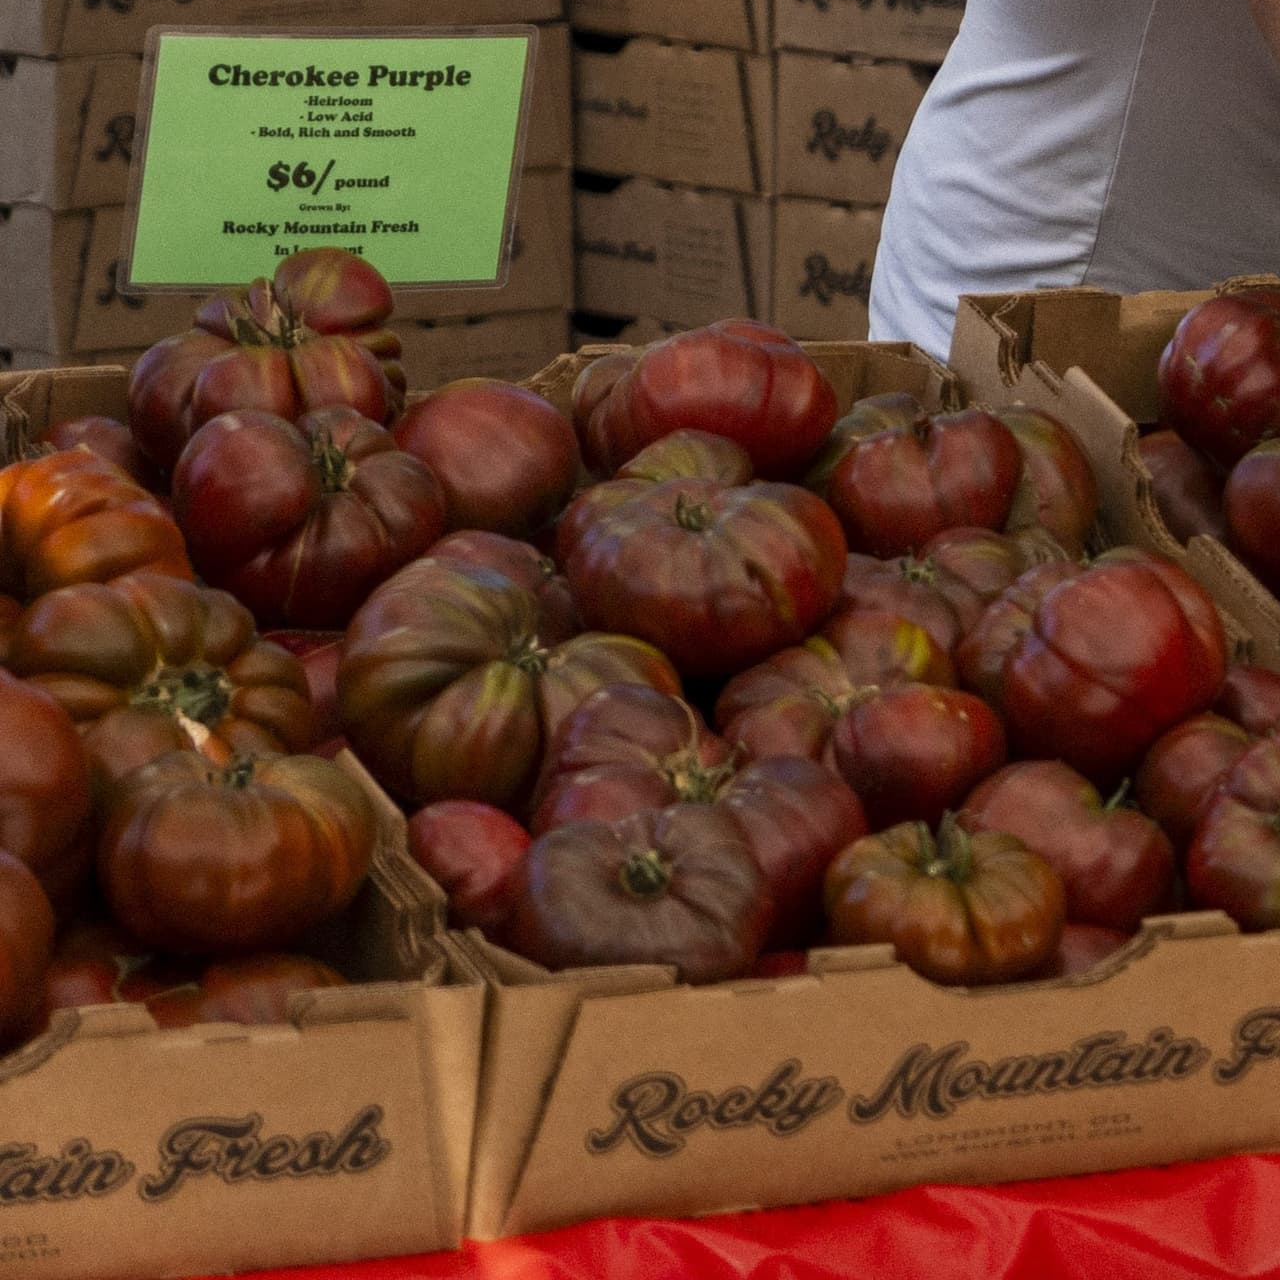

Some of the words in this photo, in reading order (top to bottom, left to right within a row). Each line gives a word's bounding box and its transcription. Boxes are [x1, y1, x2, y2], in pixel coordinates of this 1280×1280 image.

[208, 63, 360, 88] Cherokee
[367, 64, 472, 91] Purple
[304, 95, 373, 107] -Heirloom
[307, 111, 339, 122] Low
[341, 111, 373, 122] Acid
[259, 127, 295, 139] Bold,
[298, 127, 330, 138] Rich
[334, 127, 360, 138] and
[363, 127, 417, 138] Smooth
[334, 175, 390, 191] pound
[299, 203, 333, 212] Grown
[222, 221, 279, 236] Rocky
[284, 221, 367, 234] Mountain
[371, 220, 420, 234] Fresh
[274, 244, 289, 256] In
[586, 1058, 845, 1158] Rocky
[850, 1027, 1203, 1122] Mountain
[139, 1104, 392, 1204] Fresh
